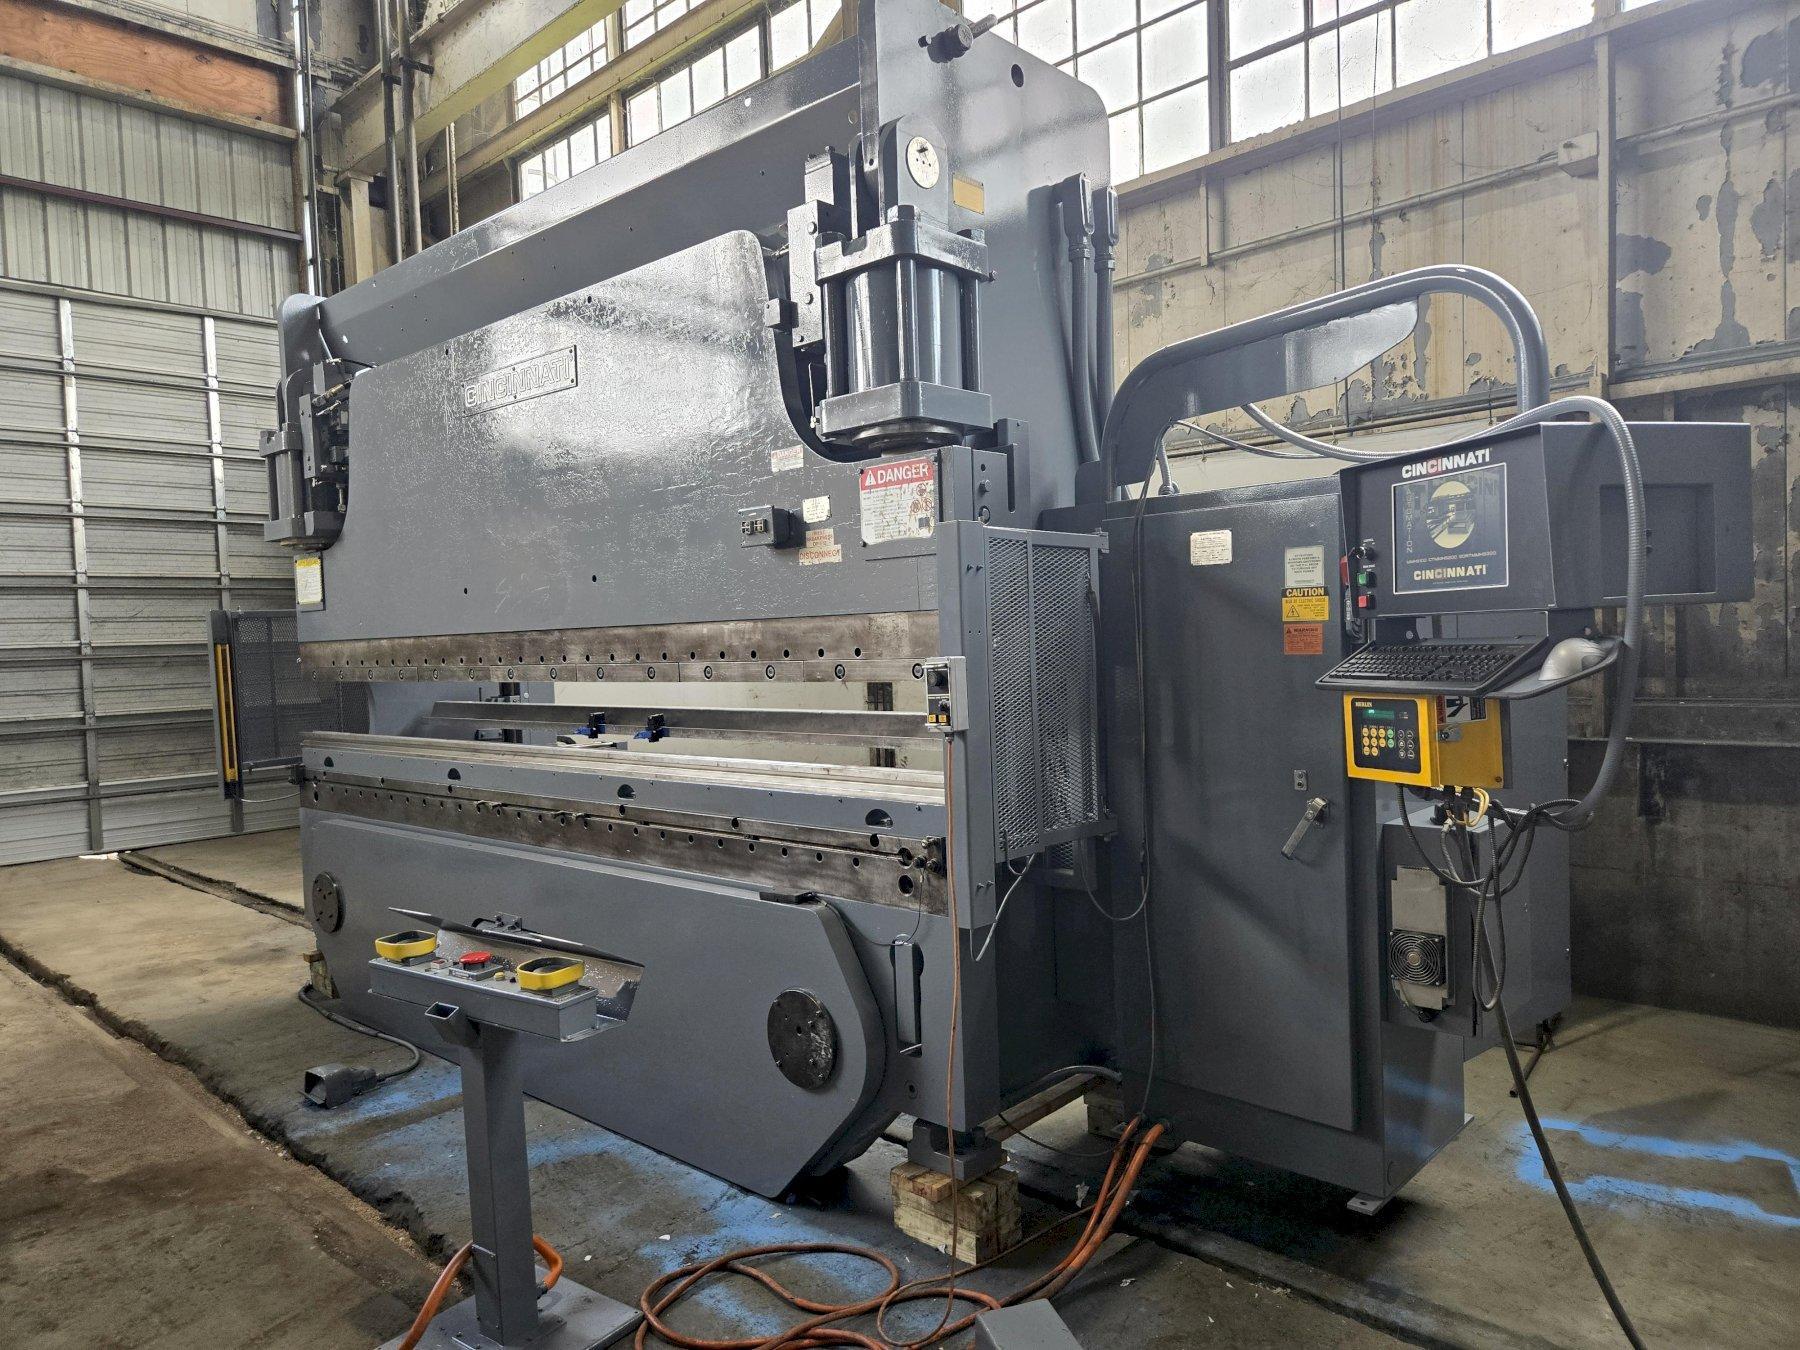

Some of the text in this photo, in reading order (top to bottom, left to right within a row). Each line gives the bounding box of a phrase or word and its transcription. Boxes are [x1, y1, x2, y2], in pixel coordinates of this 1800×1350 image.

[465, 356, 571, 407] CINCINNATI
[877, 463, 929, 483] DANGER
[1402, 448, 1490, 478] CINCINNATI
[1413, 564, 1487, 580] CINCINNATI
[1286, 587, 1325, 597] CAUTION
